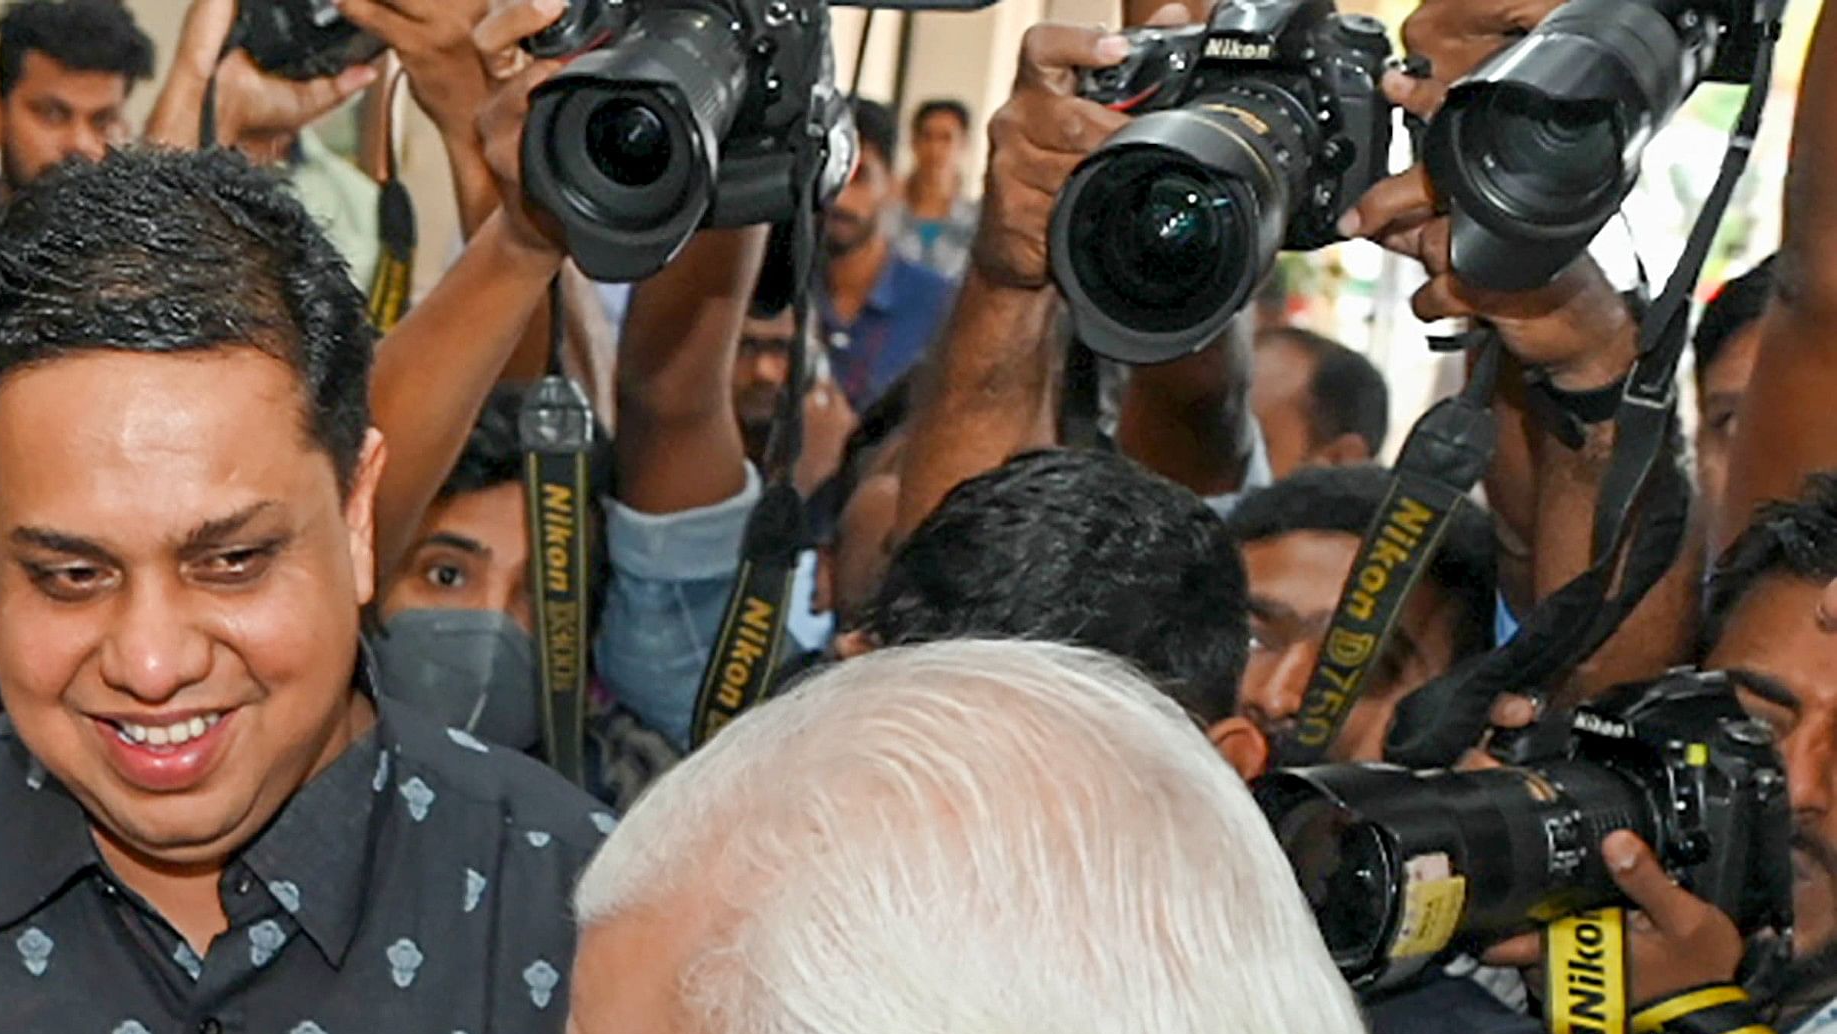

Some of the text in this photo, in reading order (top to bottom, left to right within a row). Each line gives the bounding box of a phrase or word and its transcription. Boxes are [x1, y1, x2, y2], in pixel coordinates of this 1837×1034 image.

[1204, 38, 1270, 59] Nikon
[542, 483, 573, 593] Nikon
[717, 597, 773, 709] Nikon
[1297, 497, 1434, 746] Nikon D750
[1567, 914, 1606, 1021] Niko
